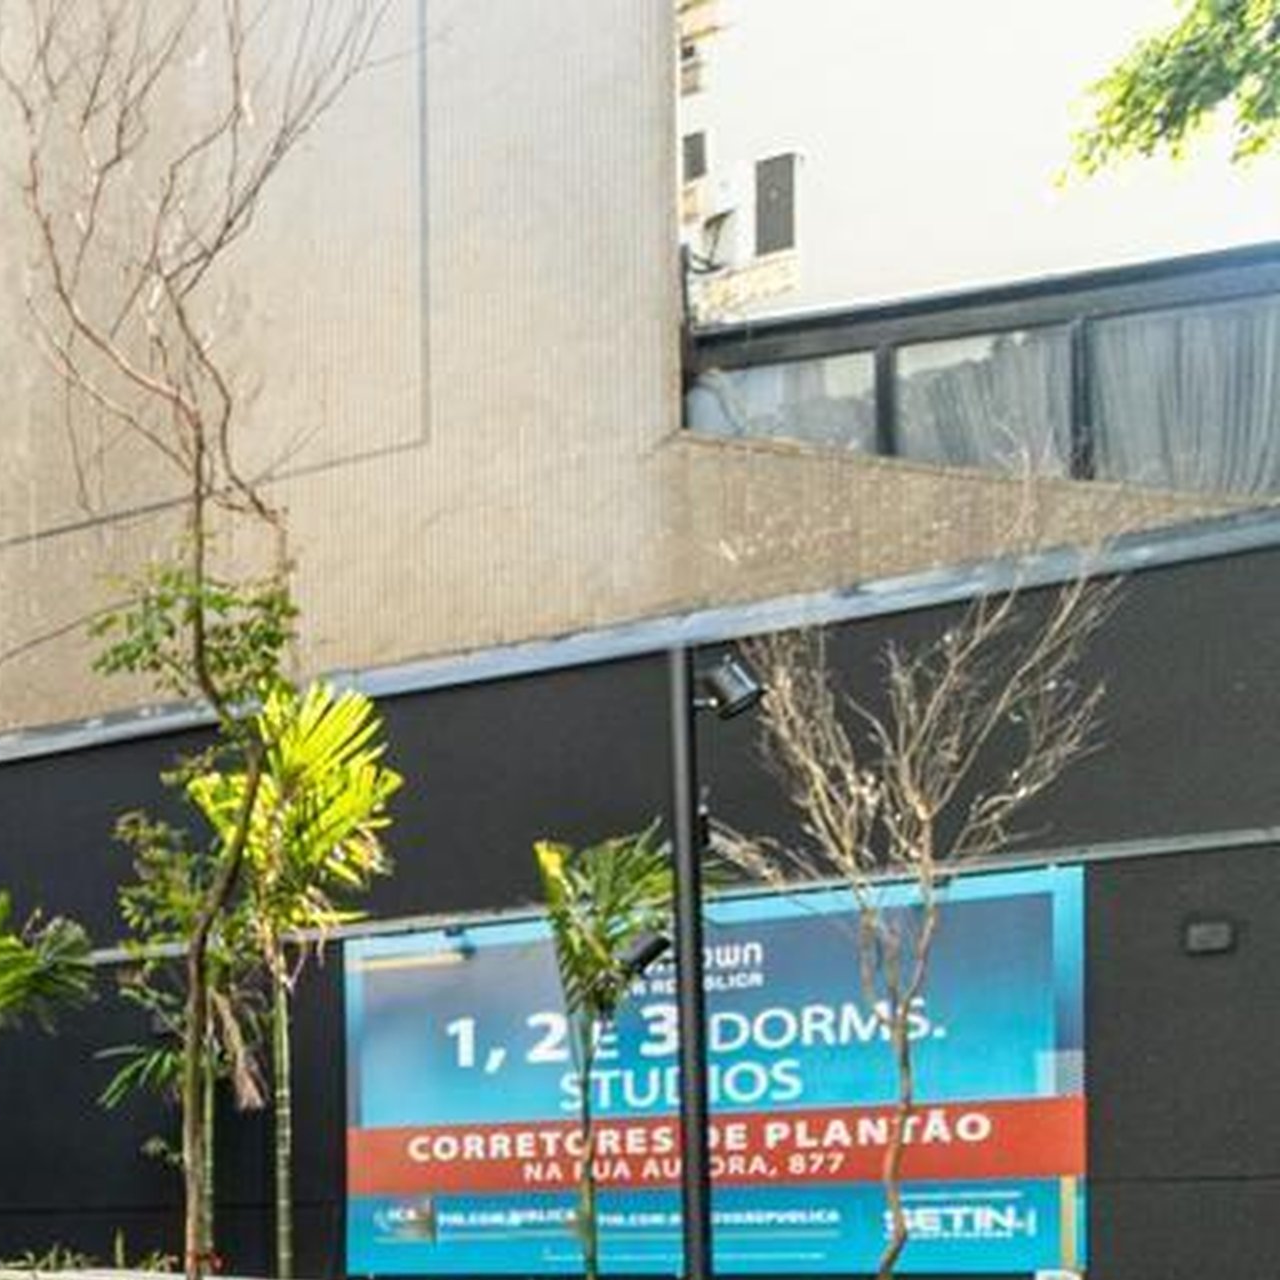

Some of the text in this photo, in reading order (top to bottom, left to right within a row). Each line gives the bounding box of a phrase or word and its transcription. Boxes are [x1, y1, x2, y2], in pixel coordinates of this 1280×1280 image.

[446, 1017, 506, 1073] 1,
[525, 1012, 570, 1063] 2
[639, 1004, 679, 1057] 3
[710, 998, 946, 1052] DORMS.
[764, 1108, 991, 1149] PLANTÃO
[523, 1163, 562, 1182] NA
[642, 1152, 778, 1178] AUORA,
[788, 1152, 844, 1174] 877
